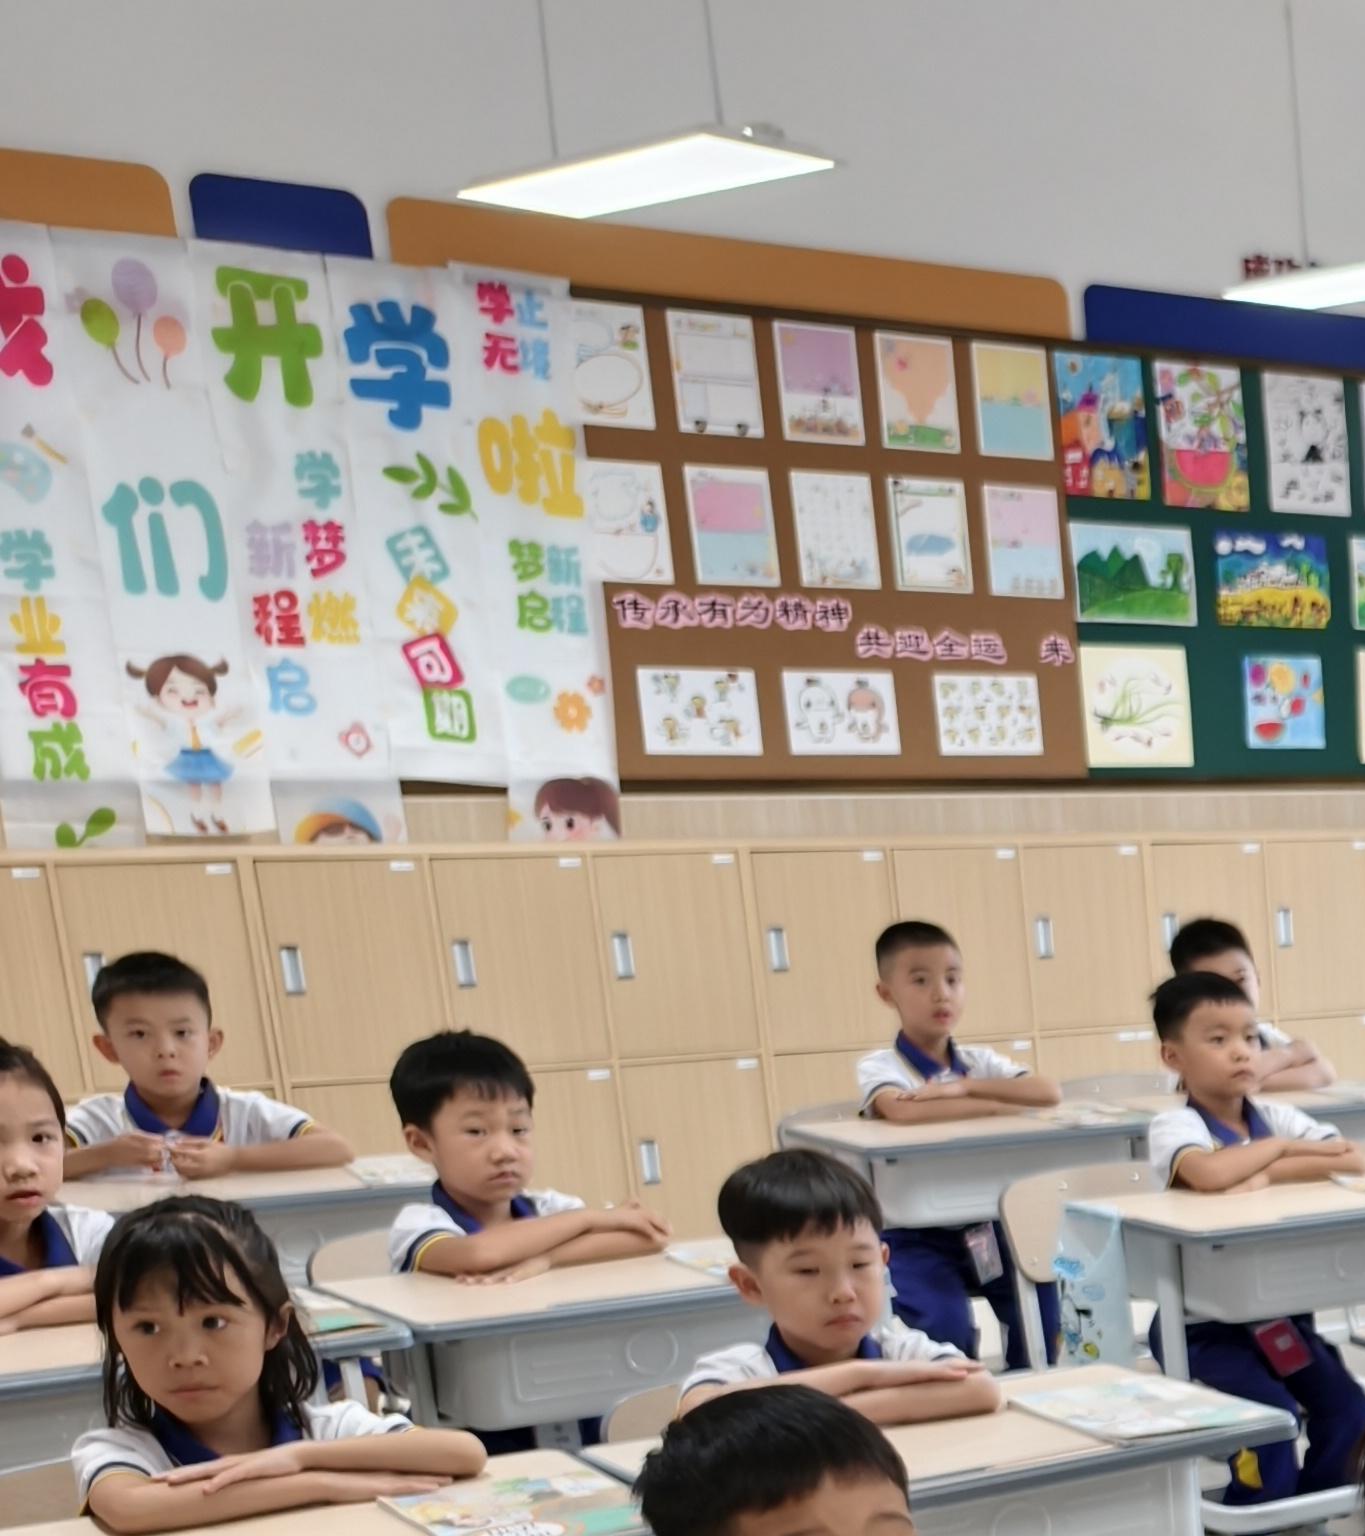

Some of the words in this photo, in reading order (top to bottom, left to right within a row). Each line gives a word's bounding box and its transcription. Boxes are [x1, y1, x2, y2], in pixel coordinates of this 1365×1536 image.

[615, 593, 851, 627] 传承有为精神
[0, 528, 91, 782] 学业有成
[858, 628, 1007, 661] 共迎全运
